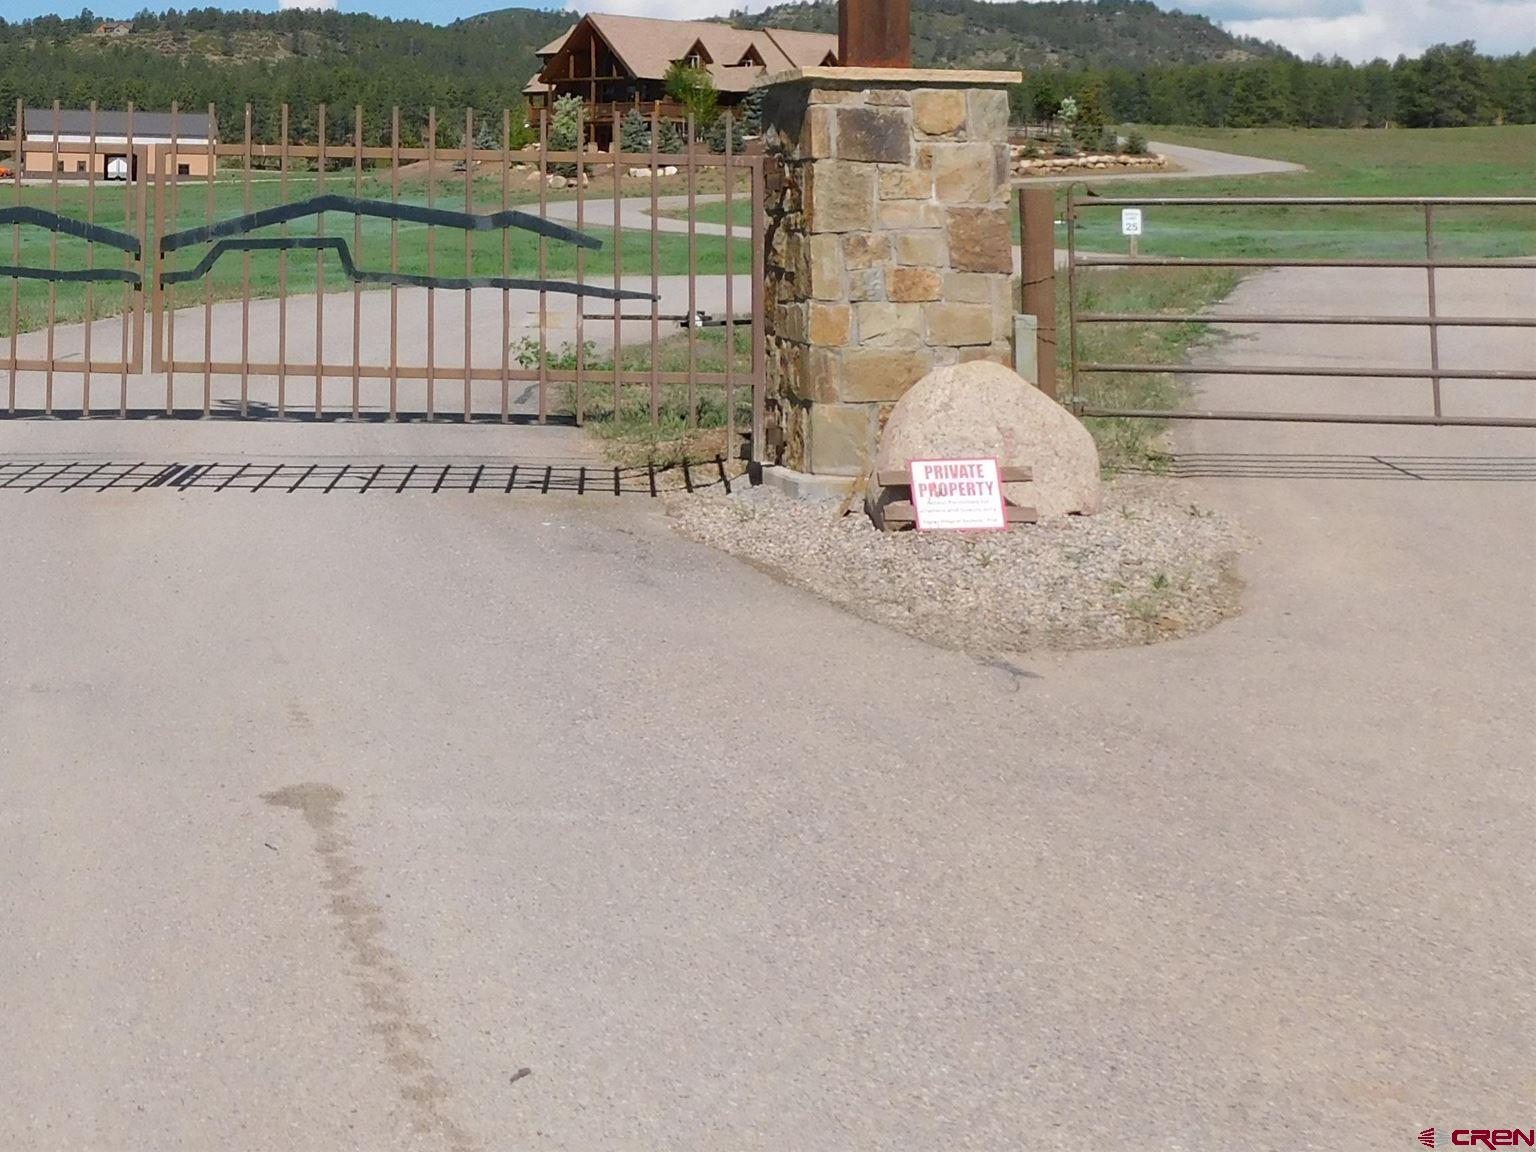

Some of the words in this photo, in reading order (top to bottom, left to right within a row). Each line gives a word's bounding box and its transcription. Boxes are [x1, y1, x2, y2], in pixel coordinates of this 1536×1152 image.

[1126, 223, 1138, 231] 25
[924, 464, 984, 480] PRIVATE
[919, 481, 993, 497] PROPERTY
